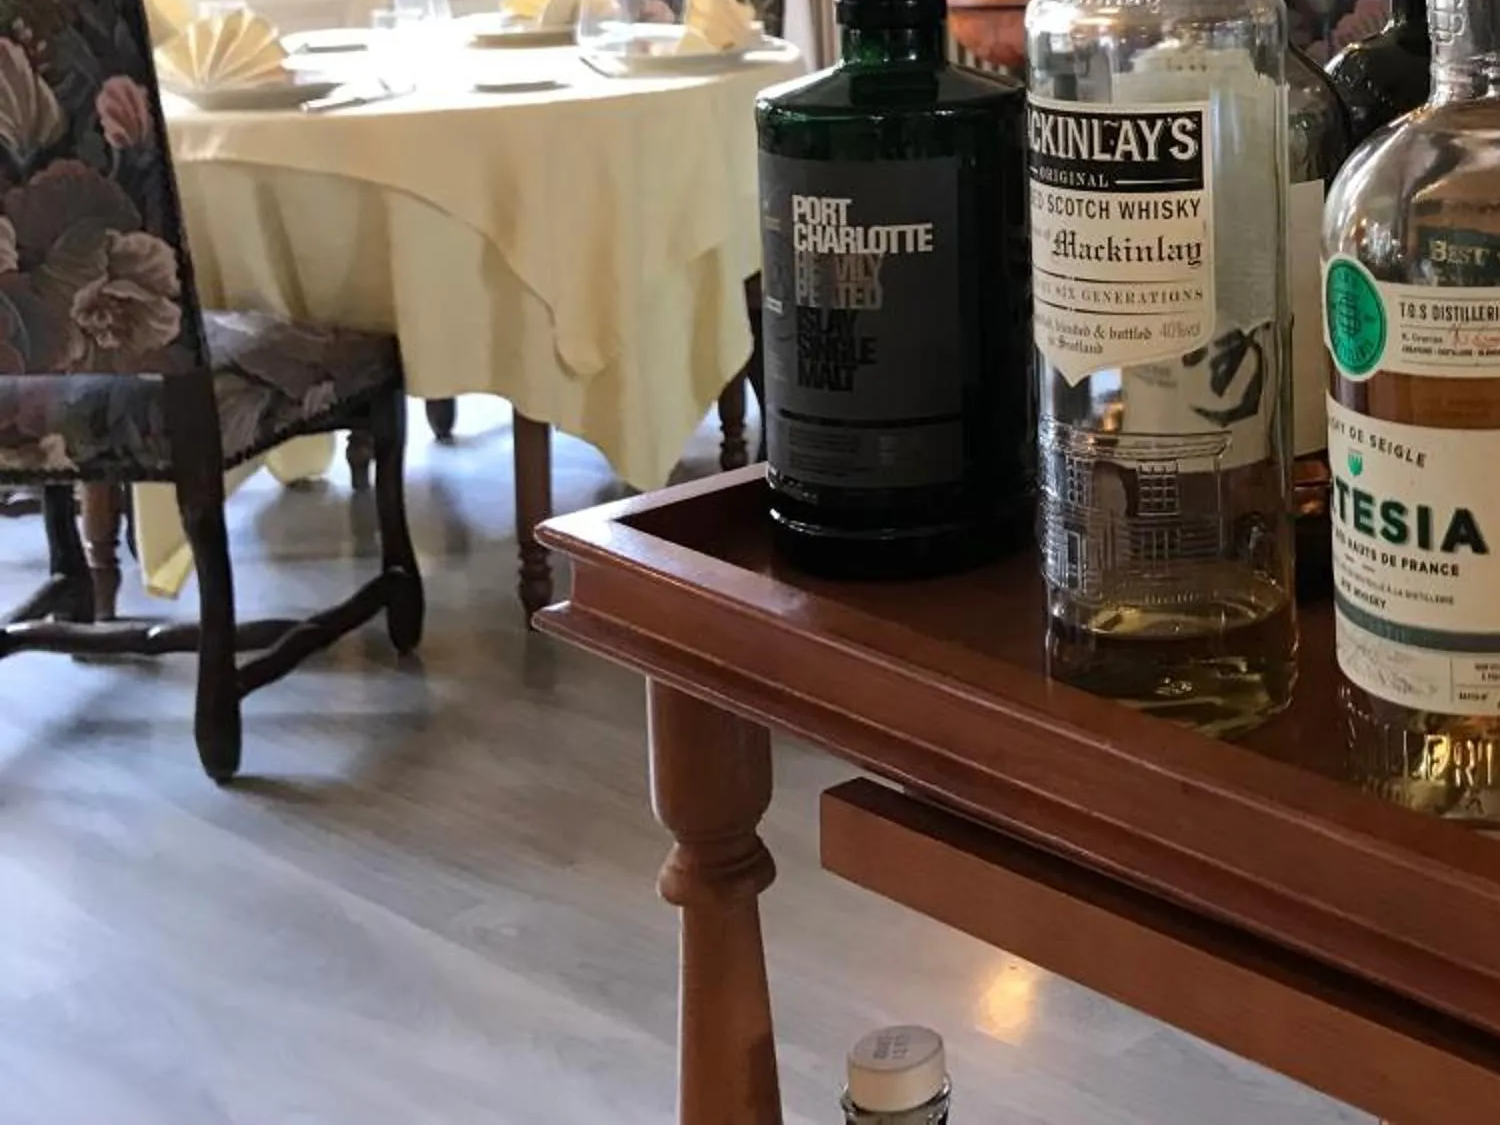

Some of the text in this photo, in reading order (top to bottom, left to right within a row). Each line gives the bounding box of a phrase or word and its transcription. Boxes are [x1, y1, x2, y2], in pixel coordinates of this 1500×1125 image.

[1028, 106, 1199, 163] CKINLAY'S
[792, 194, 853, 225] PORT
[1047, 194, 1110, 220] SCOTCH
[1118, 197, 1202, 221] WHISKY
[793, 222, 934, 254] CHARLOTTE
[1052, 229, 1203, 268] Mackinlay
[1369, 434, 1428, 469] SEIGLE
[1331, 475, 1490, 556] TESIA
[1381, 552, 1397, 568] DE
[1401, 557, 1460, 577] FRANCE
